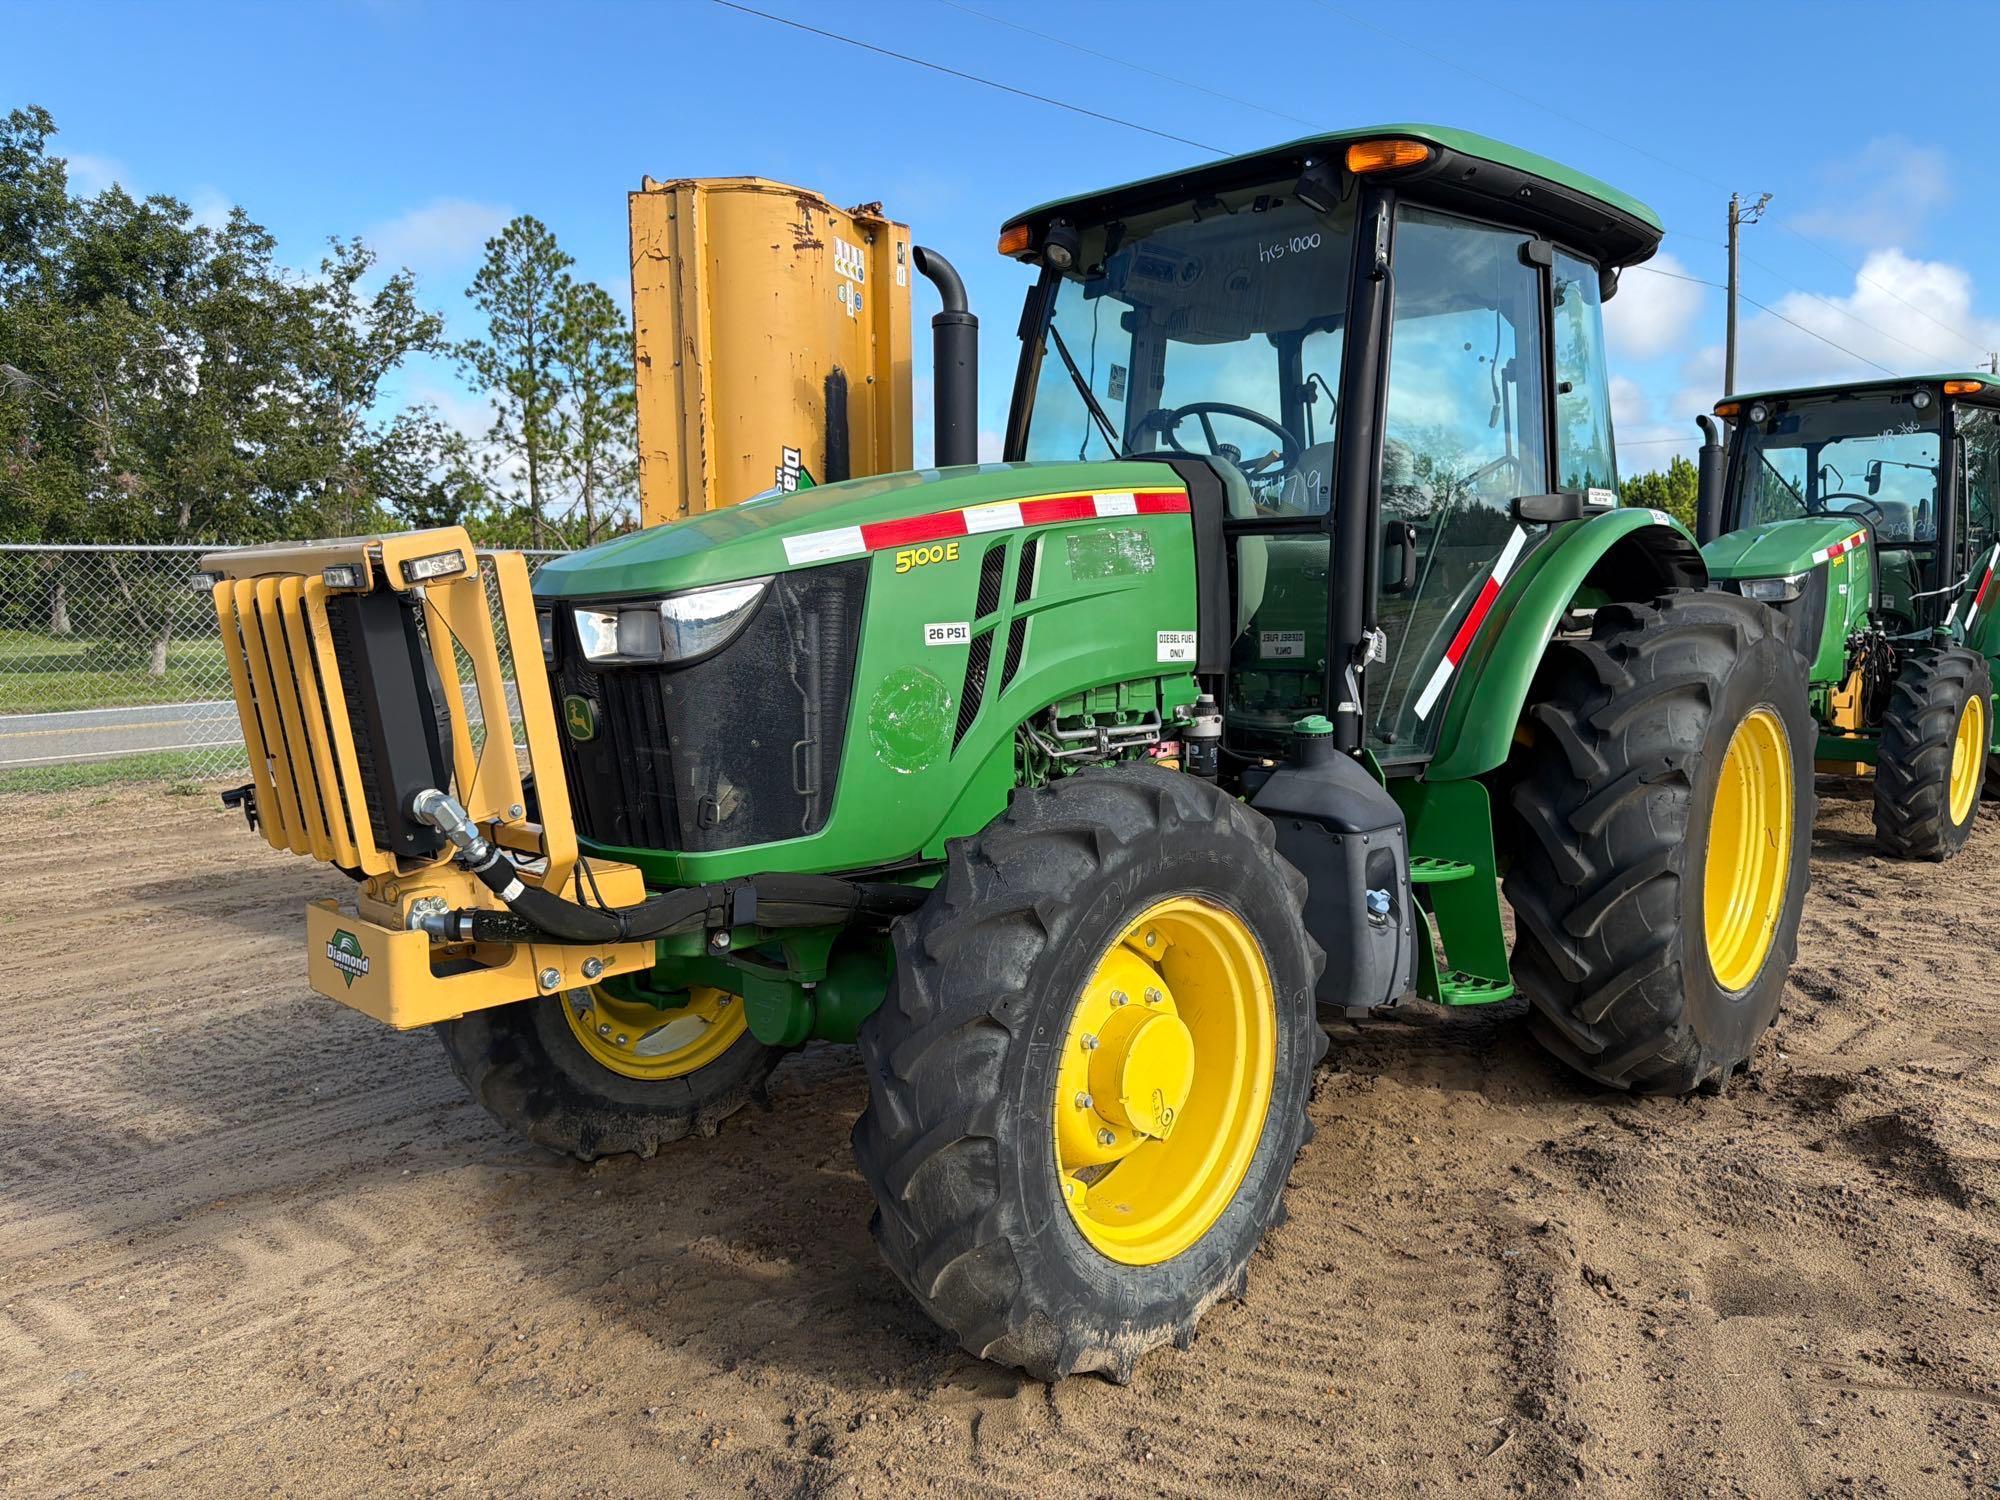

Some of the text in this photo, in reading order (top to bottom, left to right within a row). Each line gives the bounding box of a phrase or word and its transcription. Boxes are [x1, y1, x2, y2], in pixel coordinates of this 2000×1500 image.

[784, 447, 799, 494] Dia
[929, 627, 966, 640] 26 PSI
[1159, 634, 1195, 644] DIESEL FUEL
[1170, 649, 1185, 658] ONLY
[327, 943, 369, 972] Diamond
